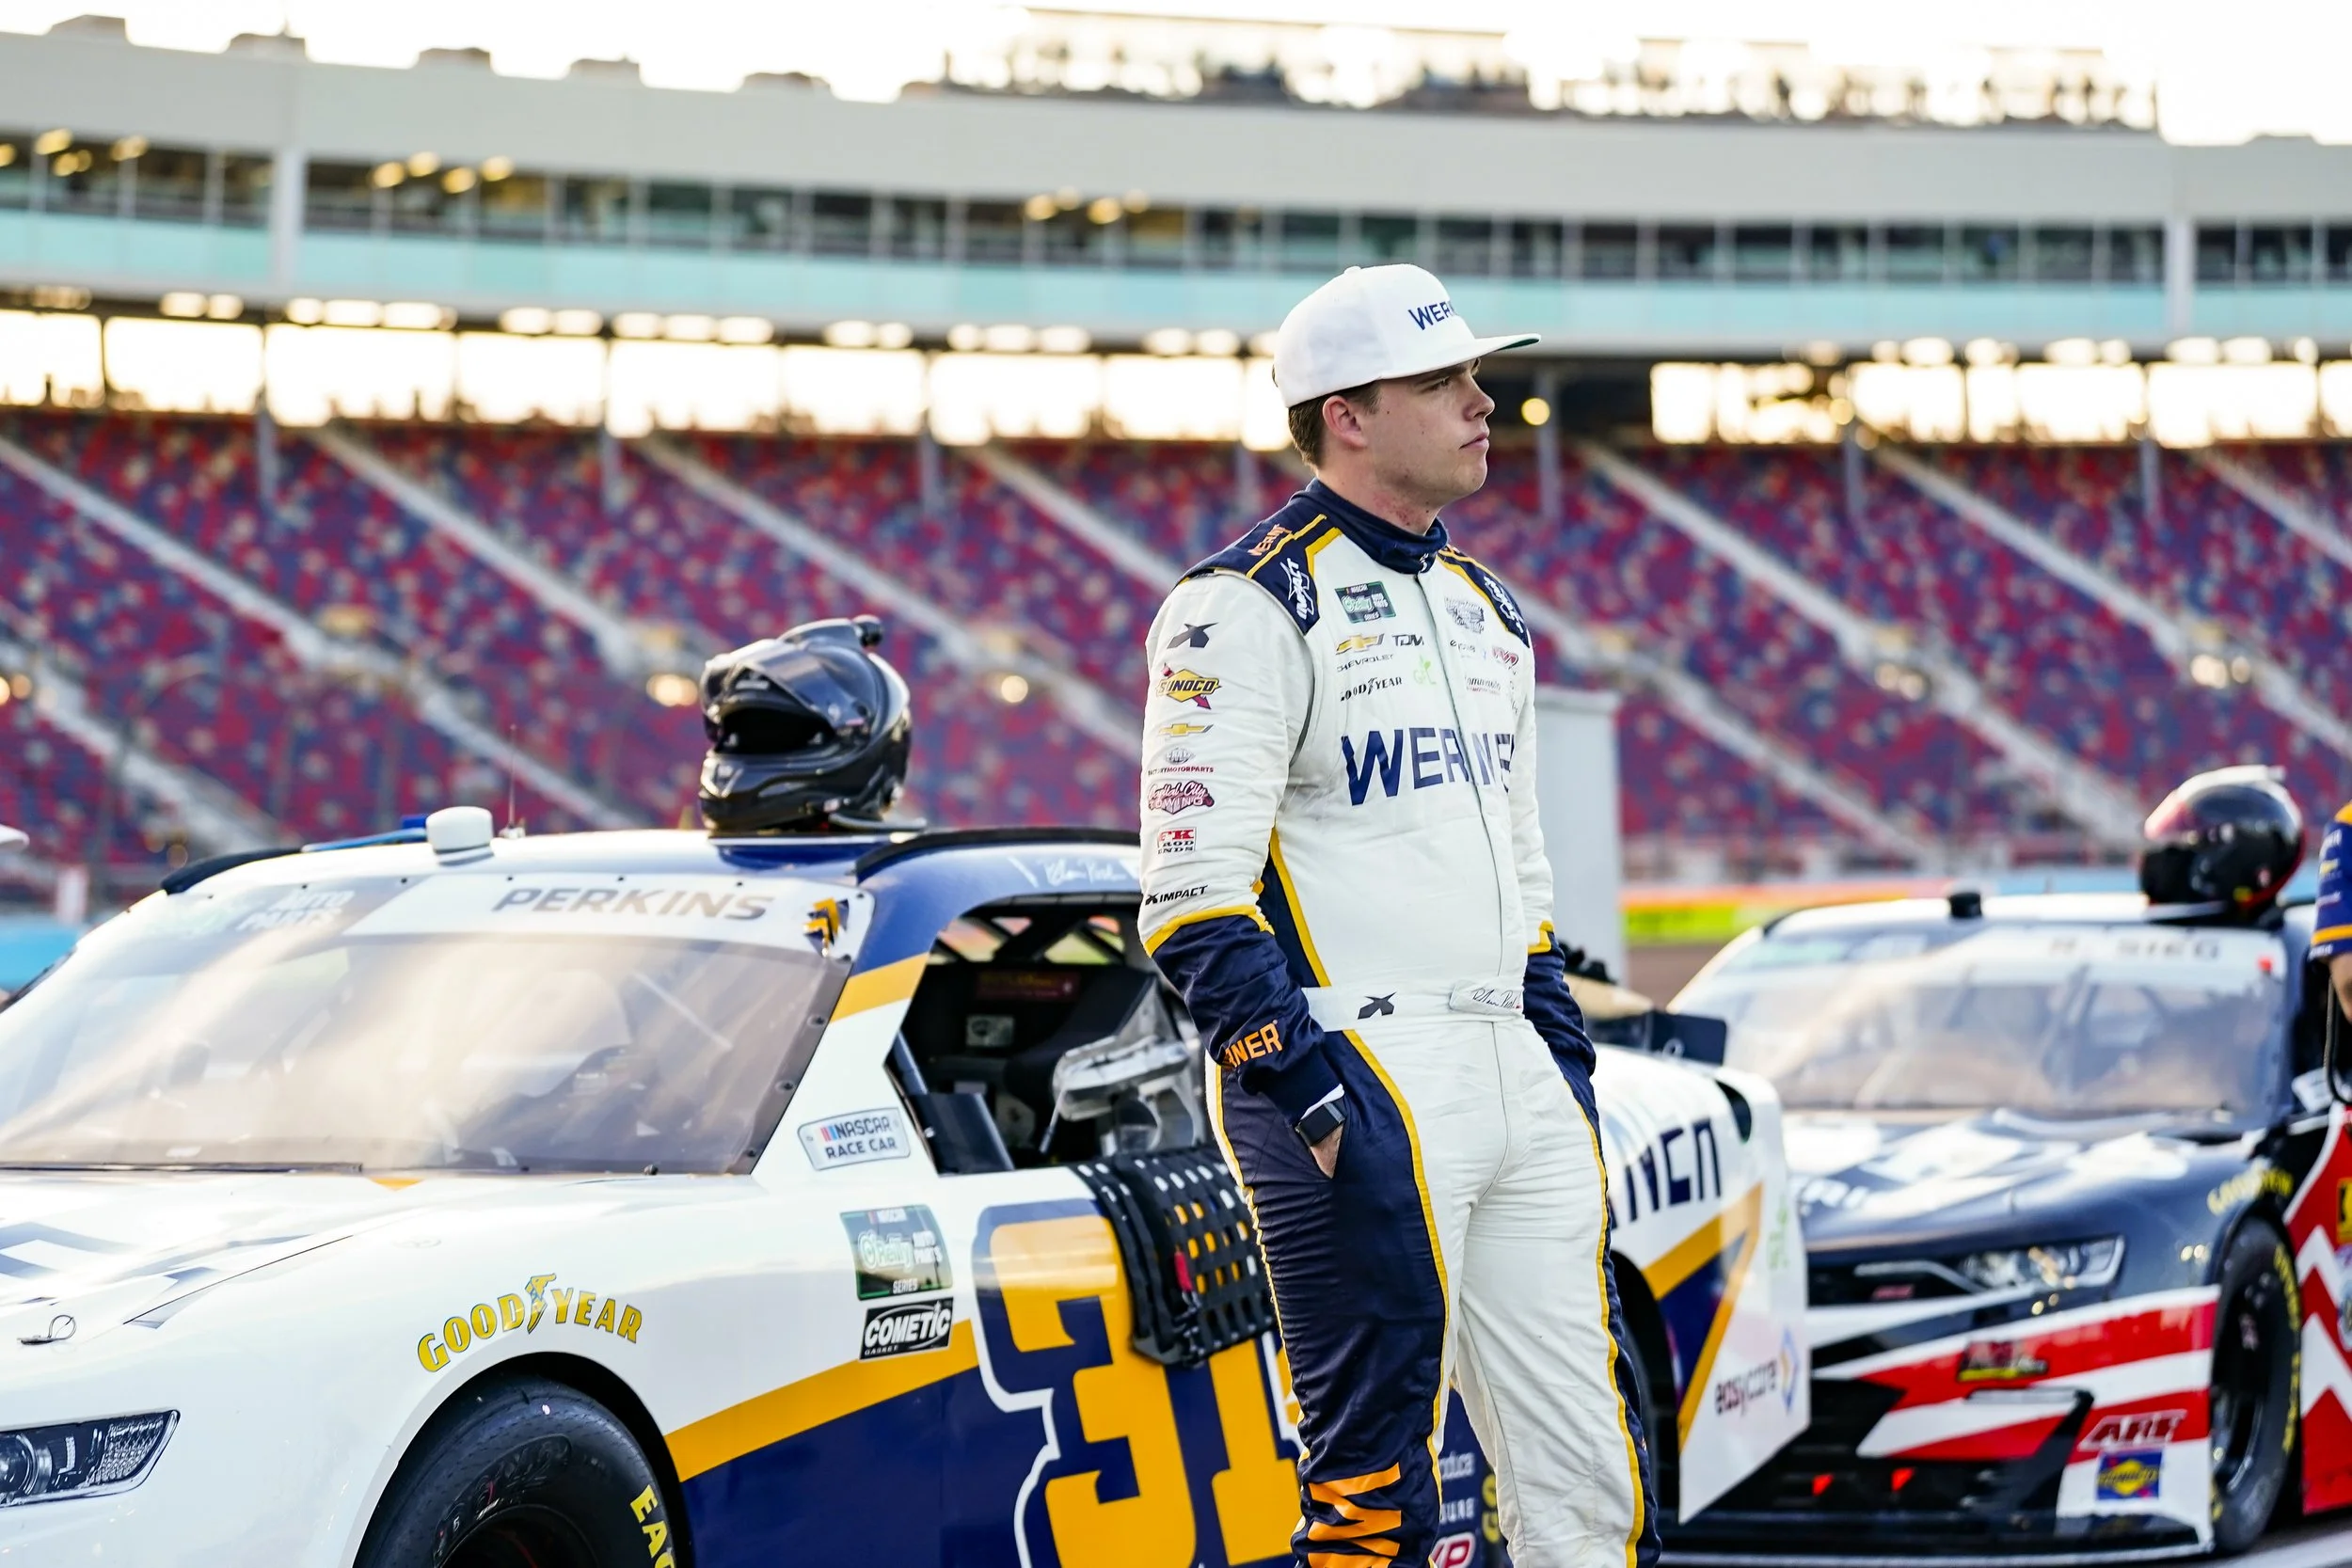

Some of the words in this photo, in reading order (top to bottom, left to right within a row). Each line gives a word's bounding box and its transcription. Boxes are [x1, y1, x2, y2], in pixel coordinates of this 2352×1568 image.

[1159, 679, 1216, 694] SUNOCO
[1341, 727, 1516, 806] WERNE
[1149, 796, 1204, 810] TOWING
[1159, 830, 1195, 843] FK
[491, 887, 775, 920] PERKINS
[834, 1116, 892, 1140] NASCAR
[825, 1139, 866, 1160] RACE
[868, 1136, 898, 1153] CAR
[417, 1273, 644, 1372] GOODYEAR
[864, 1300, 951, 1348] COMETIC
